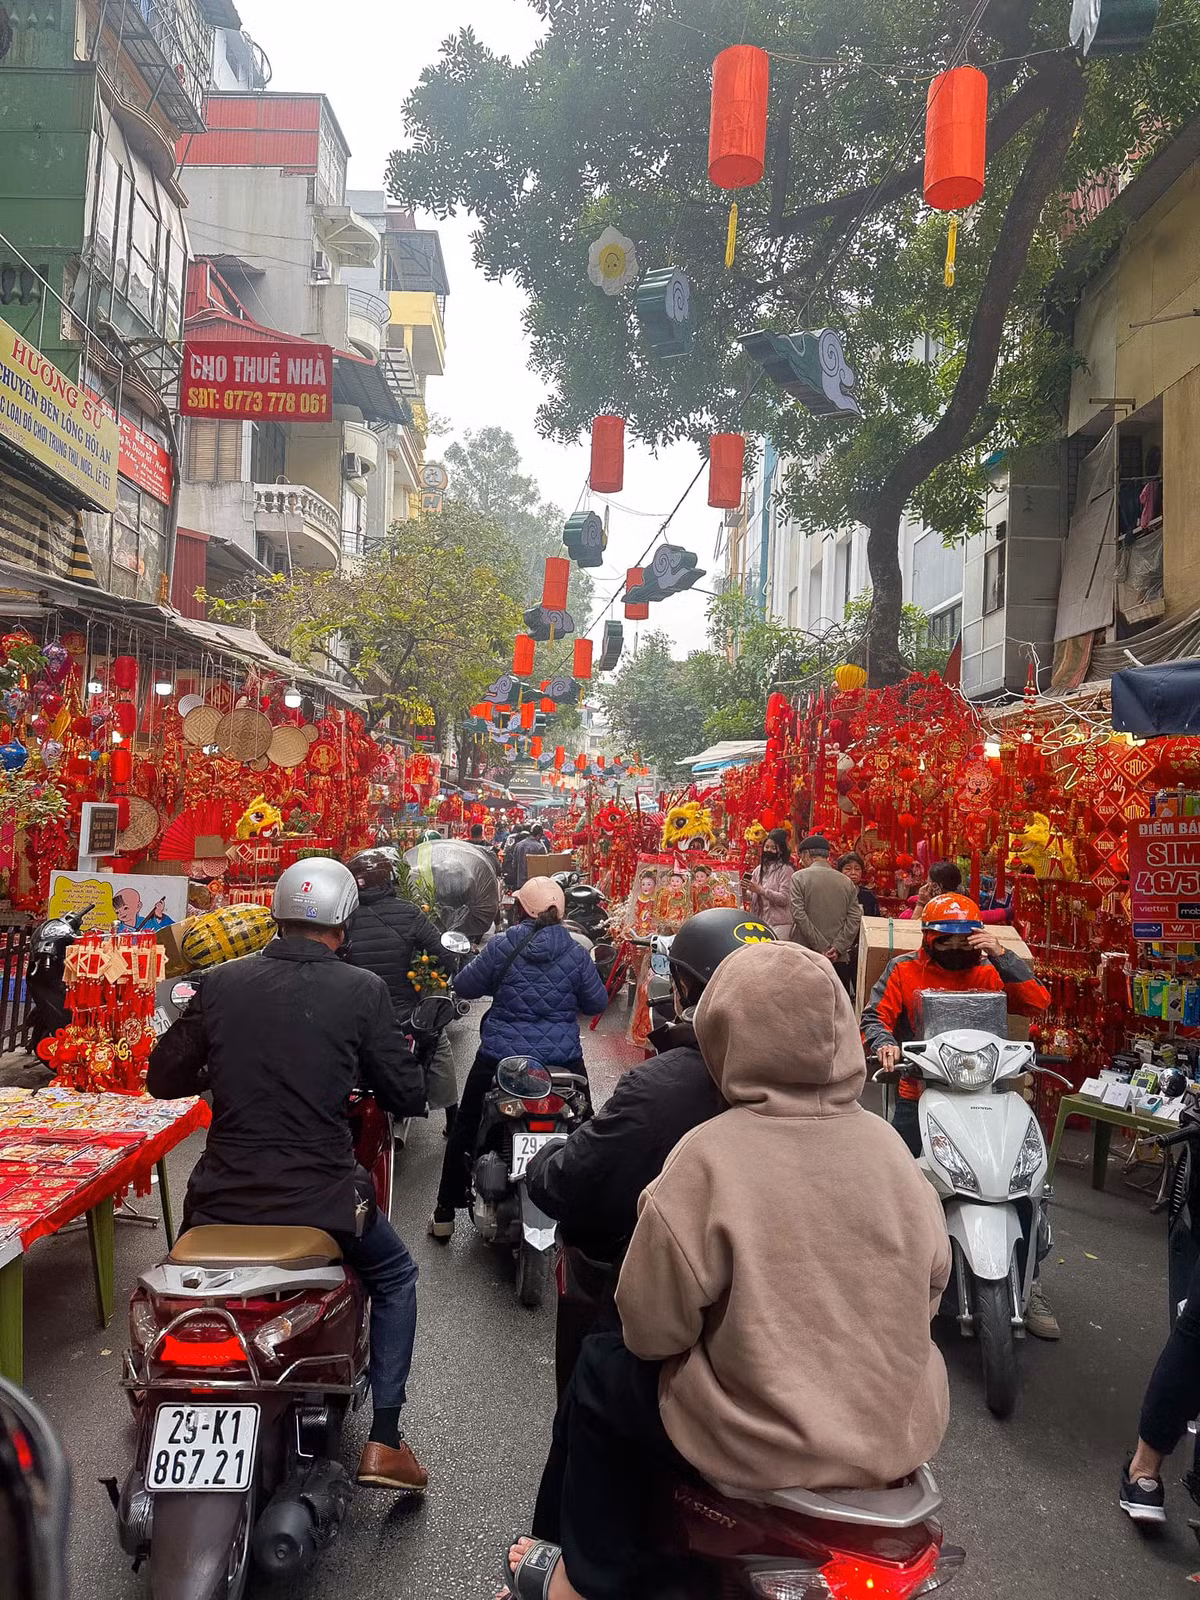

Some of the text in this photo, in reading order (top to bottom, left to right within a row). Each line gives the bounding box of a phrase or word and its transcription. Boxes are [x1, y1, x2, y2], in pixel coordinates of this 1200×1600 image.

[11, 338, 79, 409] HƯƠNG
[190, 352, 327, 386] CHO THUÊ NHÀ
[188, 387, 327, 414] SĐT: 0773 778 061
[7, 399, 22, 427] LOẠI
[48, 431, 68, 459] TRUNG
[40, 395, 60, 424] ĐÈN
[86, 432, 99, 457] HỘI
[100, 446, 111, 465] AN
[1124, 755, 1148, 777] CHÚC
[1139, 818, 1175, 835] ĐIỂM
[1147, 842, 1200, 867] SIM
[1139, 905, 1170, 913] viettel
[183, 1321, 228, 1329] HONDA
[168, 1410, 241, 1444] 29-K1
[154, 1449, 245, 1485] 867.21
